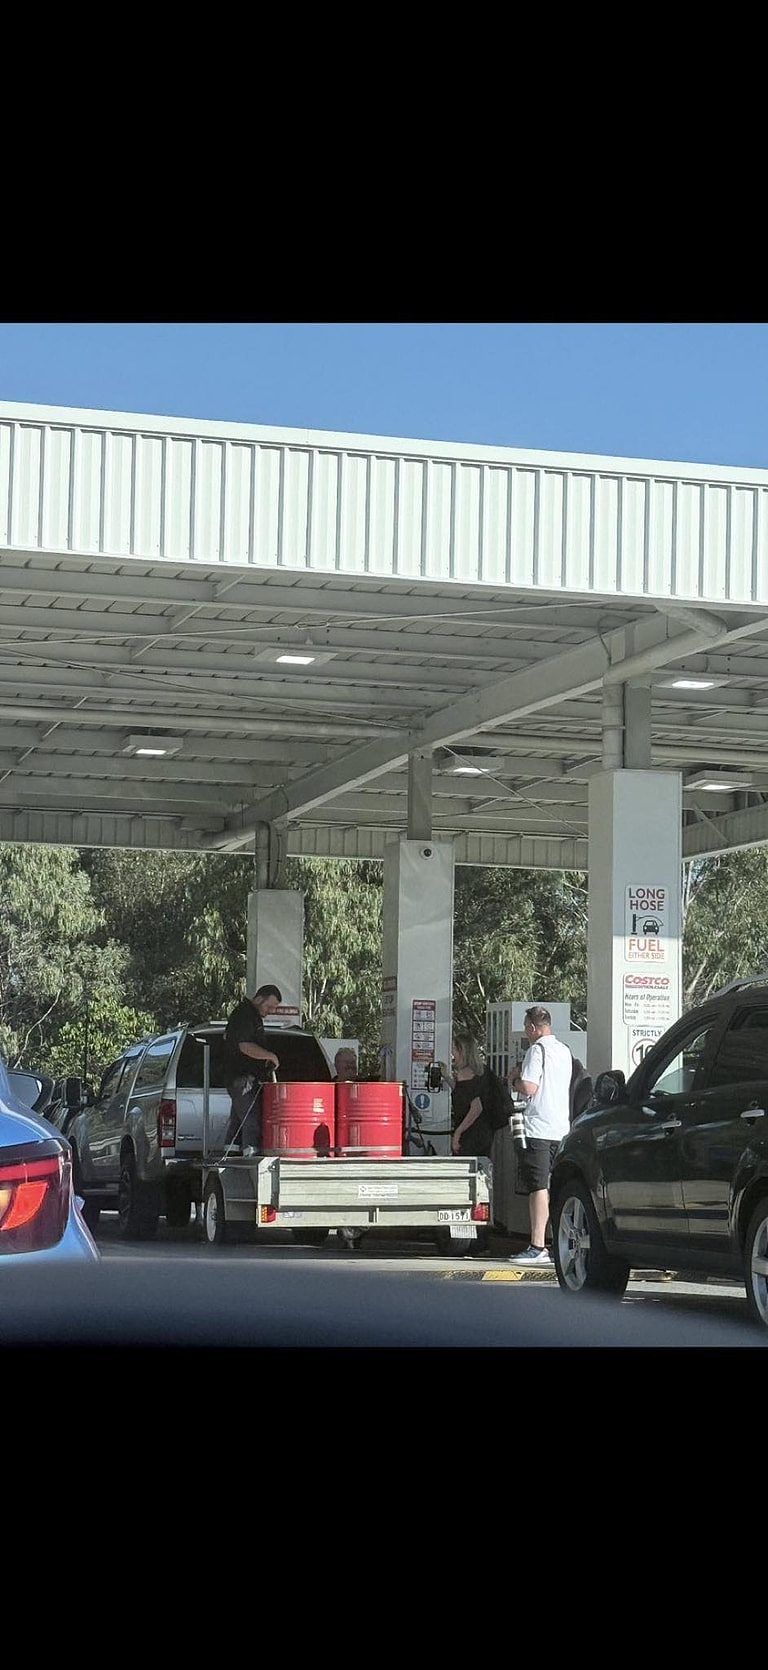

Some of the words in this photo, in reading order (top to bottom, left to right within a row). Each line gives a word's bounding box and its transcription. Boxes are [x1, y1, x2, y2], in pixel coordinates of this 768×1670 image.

[628, 887, 665, 899] LONG
[629, 899, 664, 911] HOSE
[628, 938, 665, 952] FUEL
[628, 951, 650, 959] EITHER
[651, 952, 665, 960] SIDE
[632, 1029, 662, 1037] STRICTLY
